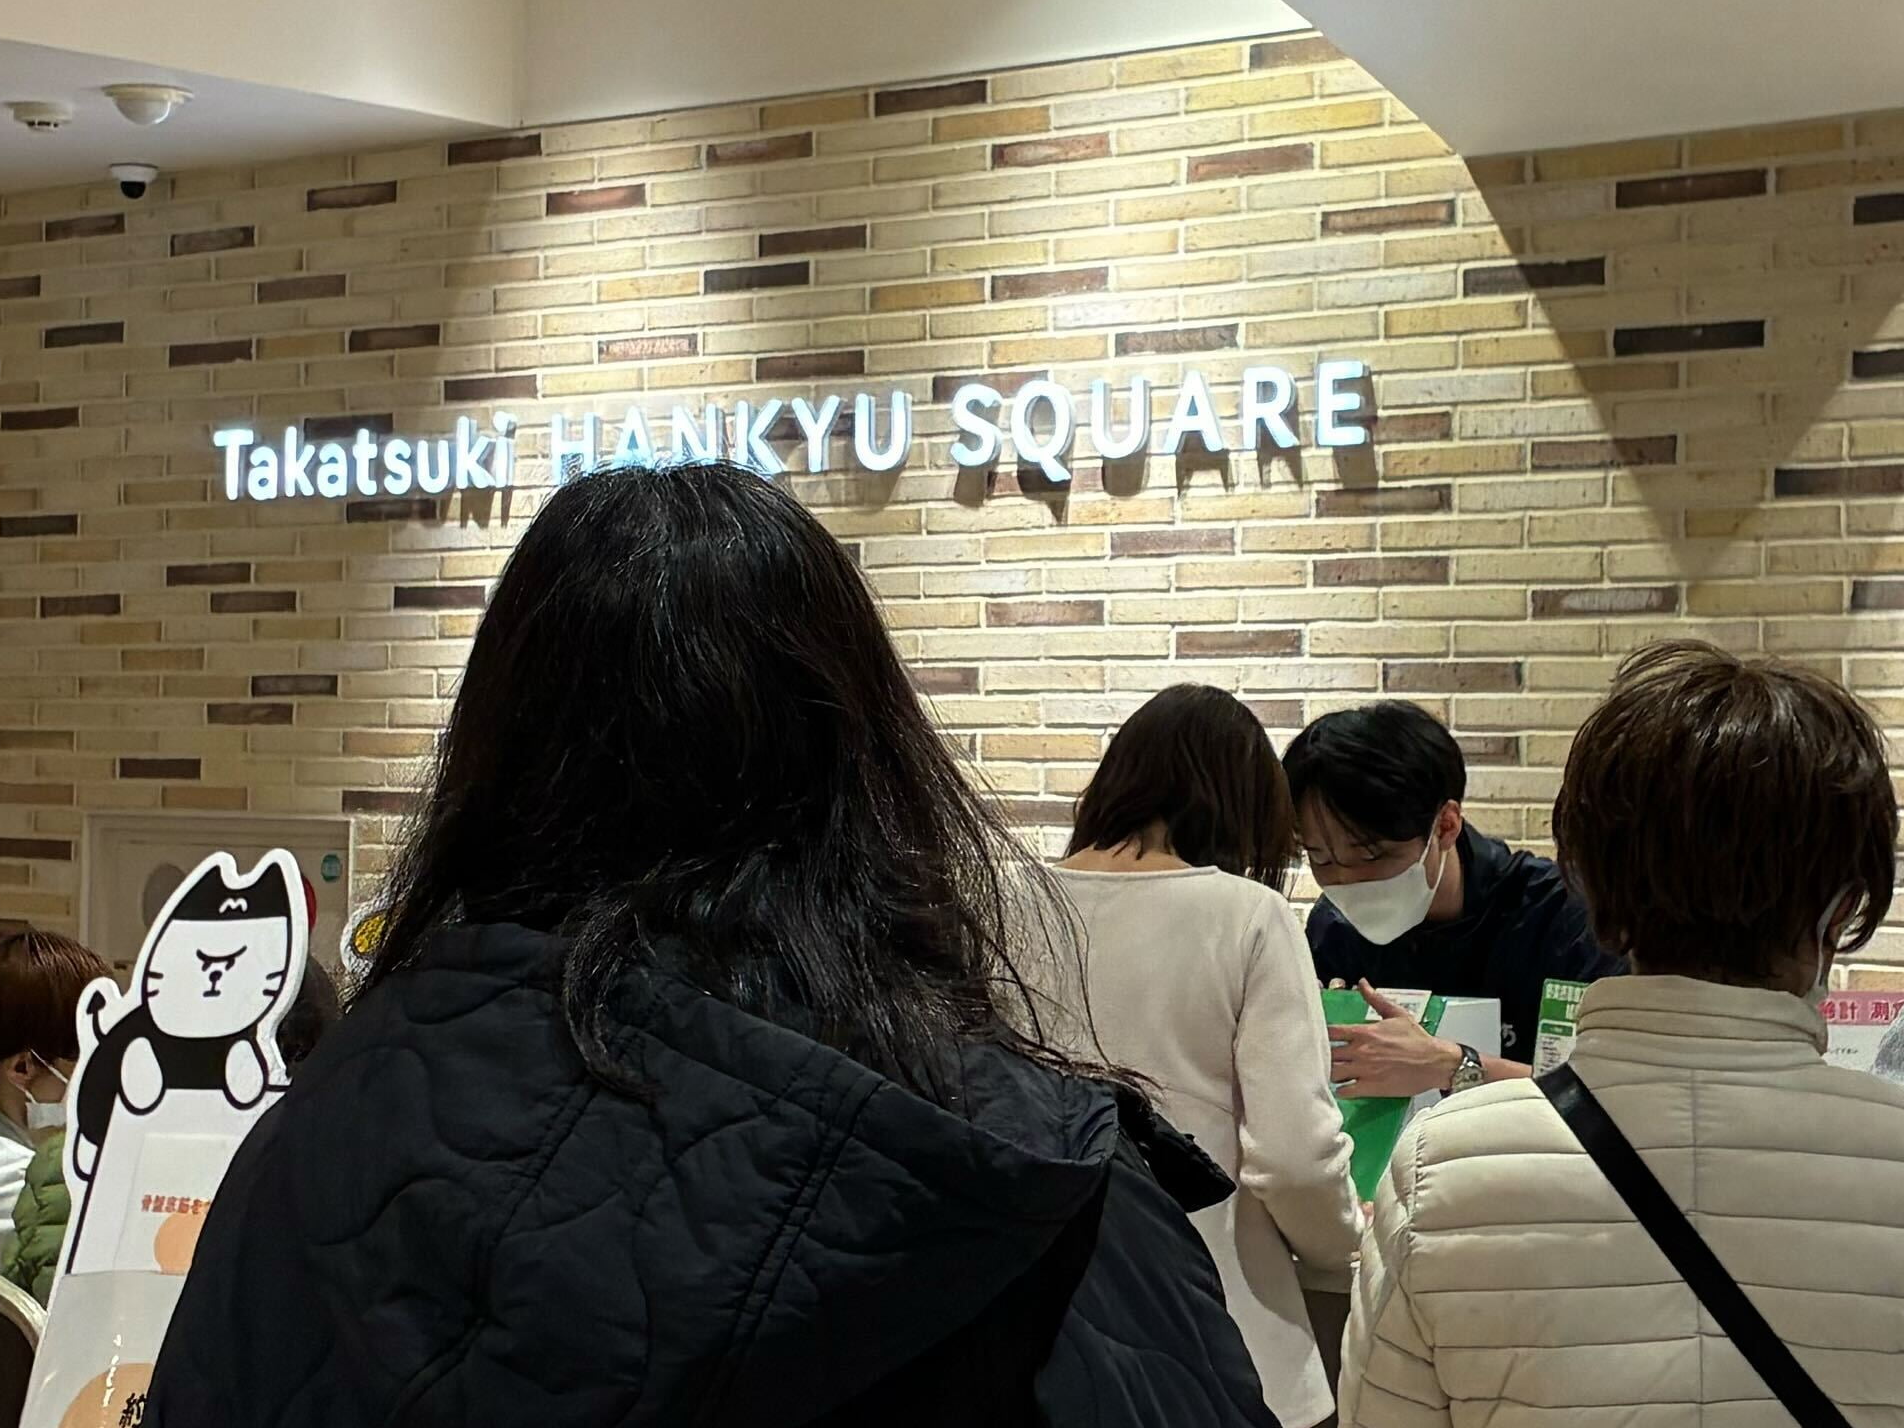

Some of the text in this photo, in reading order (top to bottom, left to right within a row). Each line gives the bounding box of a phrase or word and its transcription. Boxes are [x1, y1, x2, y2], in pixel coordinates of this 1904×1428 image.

[212, 359, 1371, 502] Takatsuki HANKYU SQUARE
